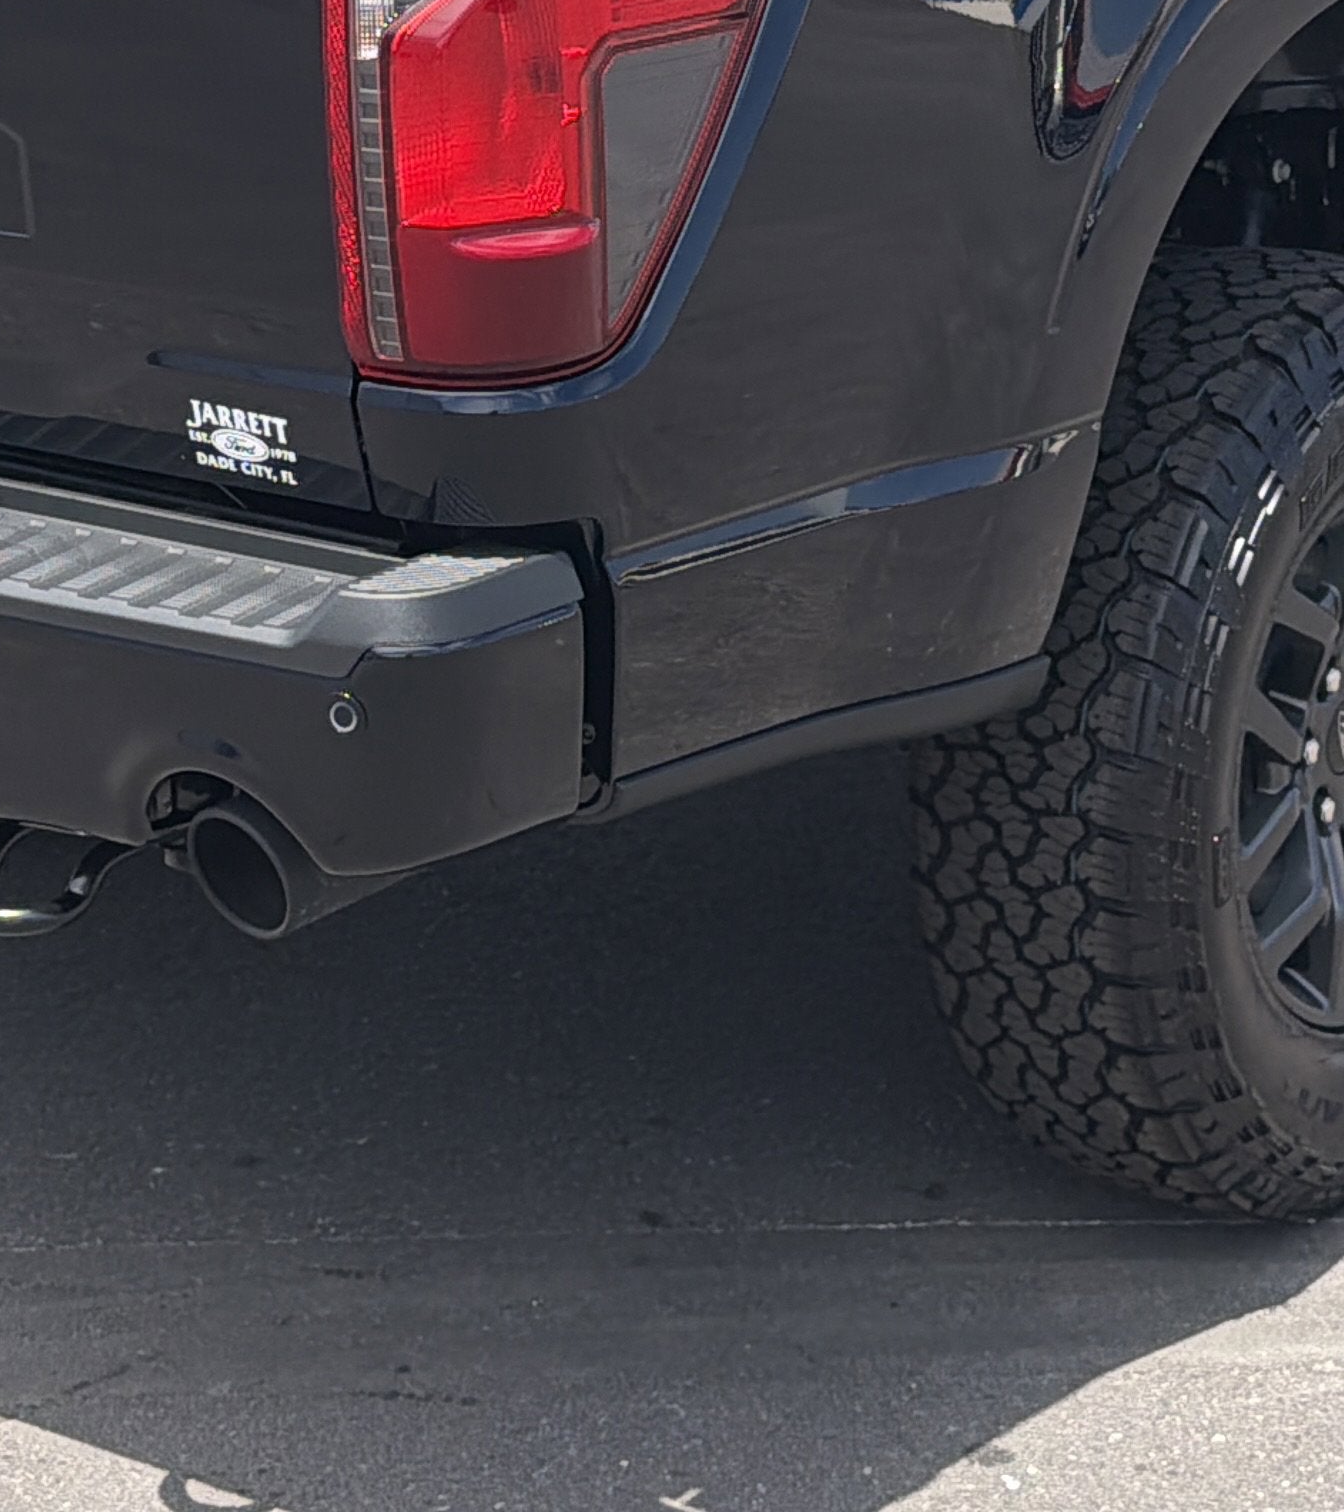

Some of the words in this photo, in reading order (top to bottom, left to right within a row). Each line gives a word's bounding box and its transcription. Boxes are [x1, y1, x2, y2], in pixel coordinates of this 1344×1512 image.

[185, 398, 288, 445] JARRETT
[196, 451, 237, 473] DADE
[280, 469, 299, 486] FL
